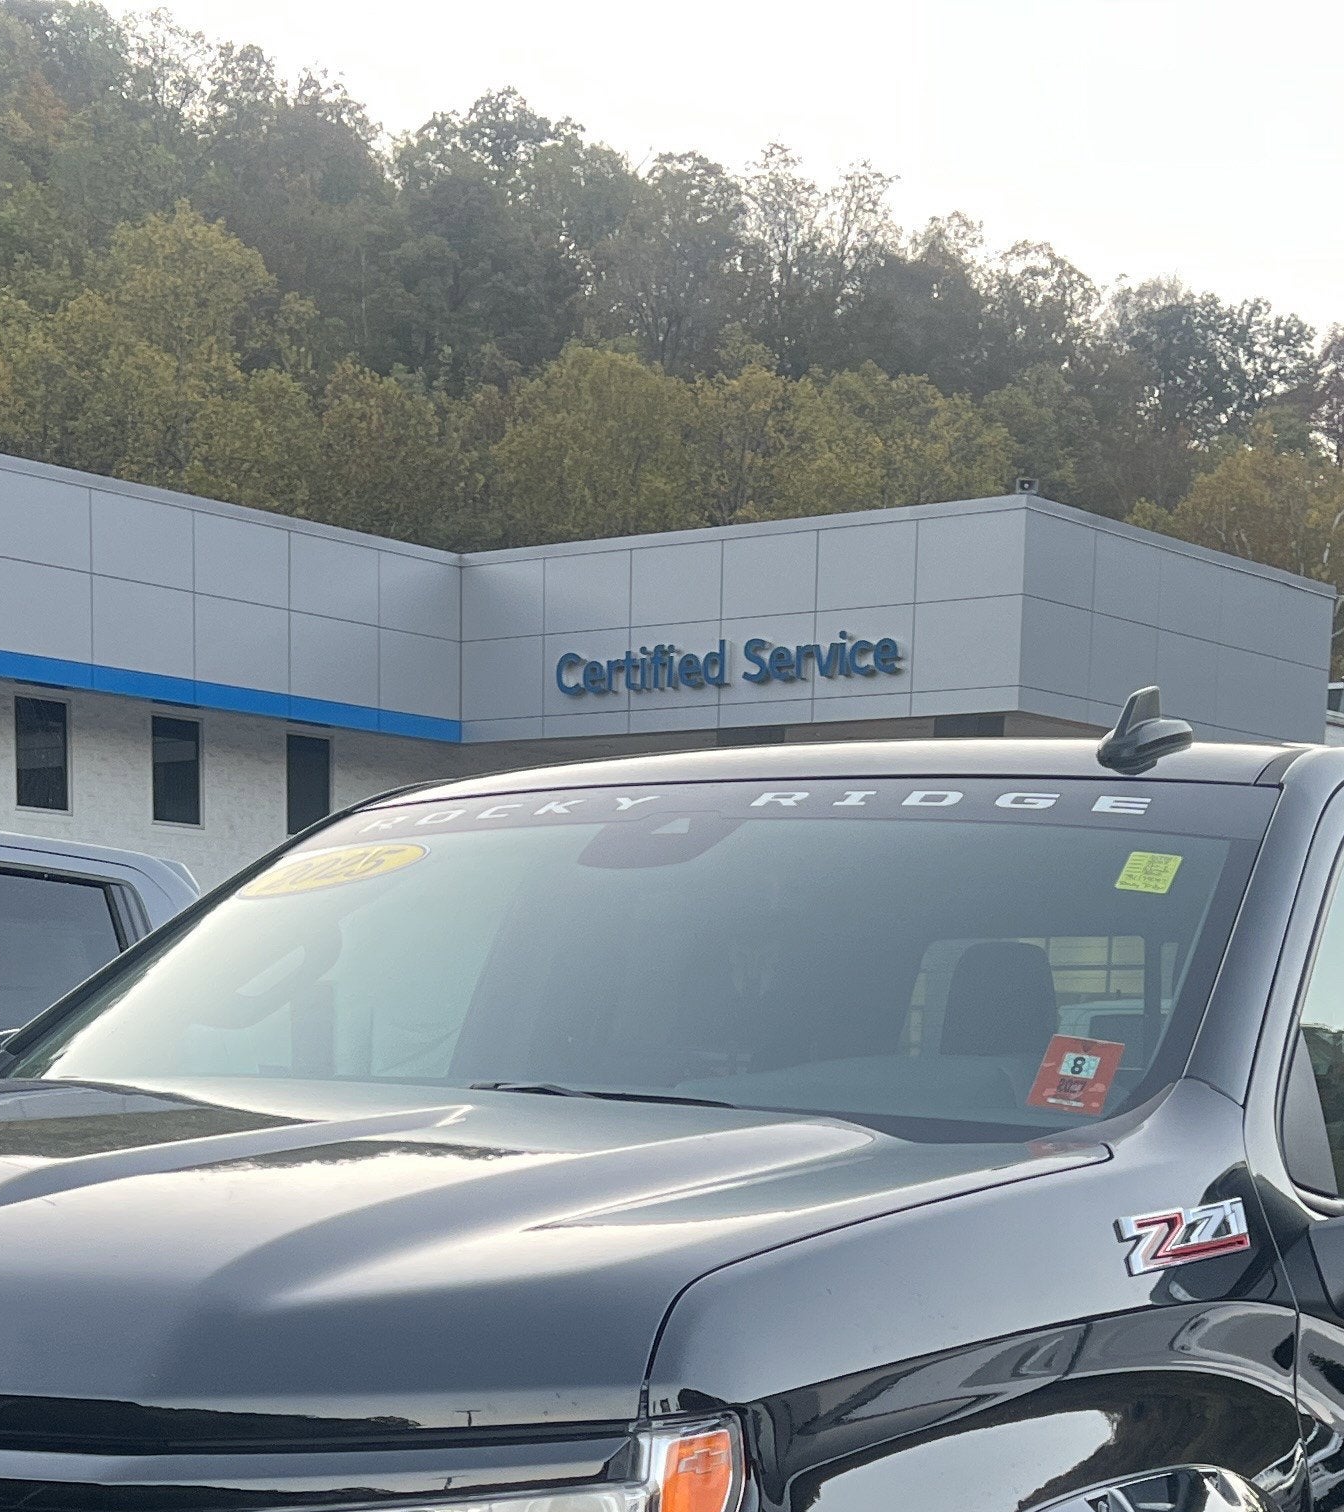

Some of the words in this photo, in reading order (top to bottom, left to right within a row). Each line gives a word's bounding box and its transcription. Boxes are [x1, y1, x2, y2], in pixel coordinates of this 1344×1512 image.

[556, 639, 729, 695] Certified
[742, 630, 903, 684] Service
[357, 795, 661, 833] ROCKY
[750, 790, 1152, 815] RIDGE
[1070, 1056, 1086, 1075] 8
[1113, 1197, 1250, 1276] Z71
